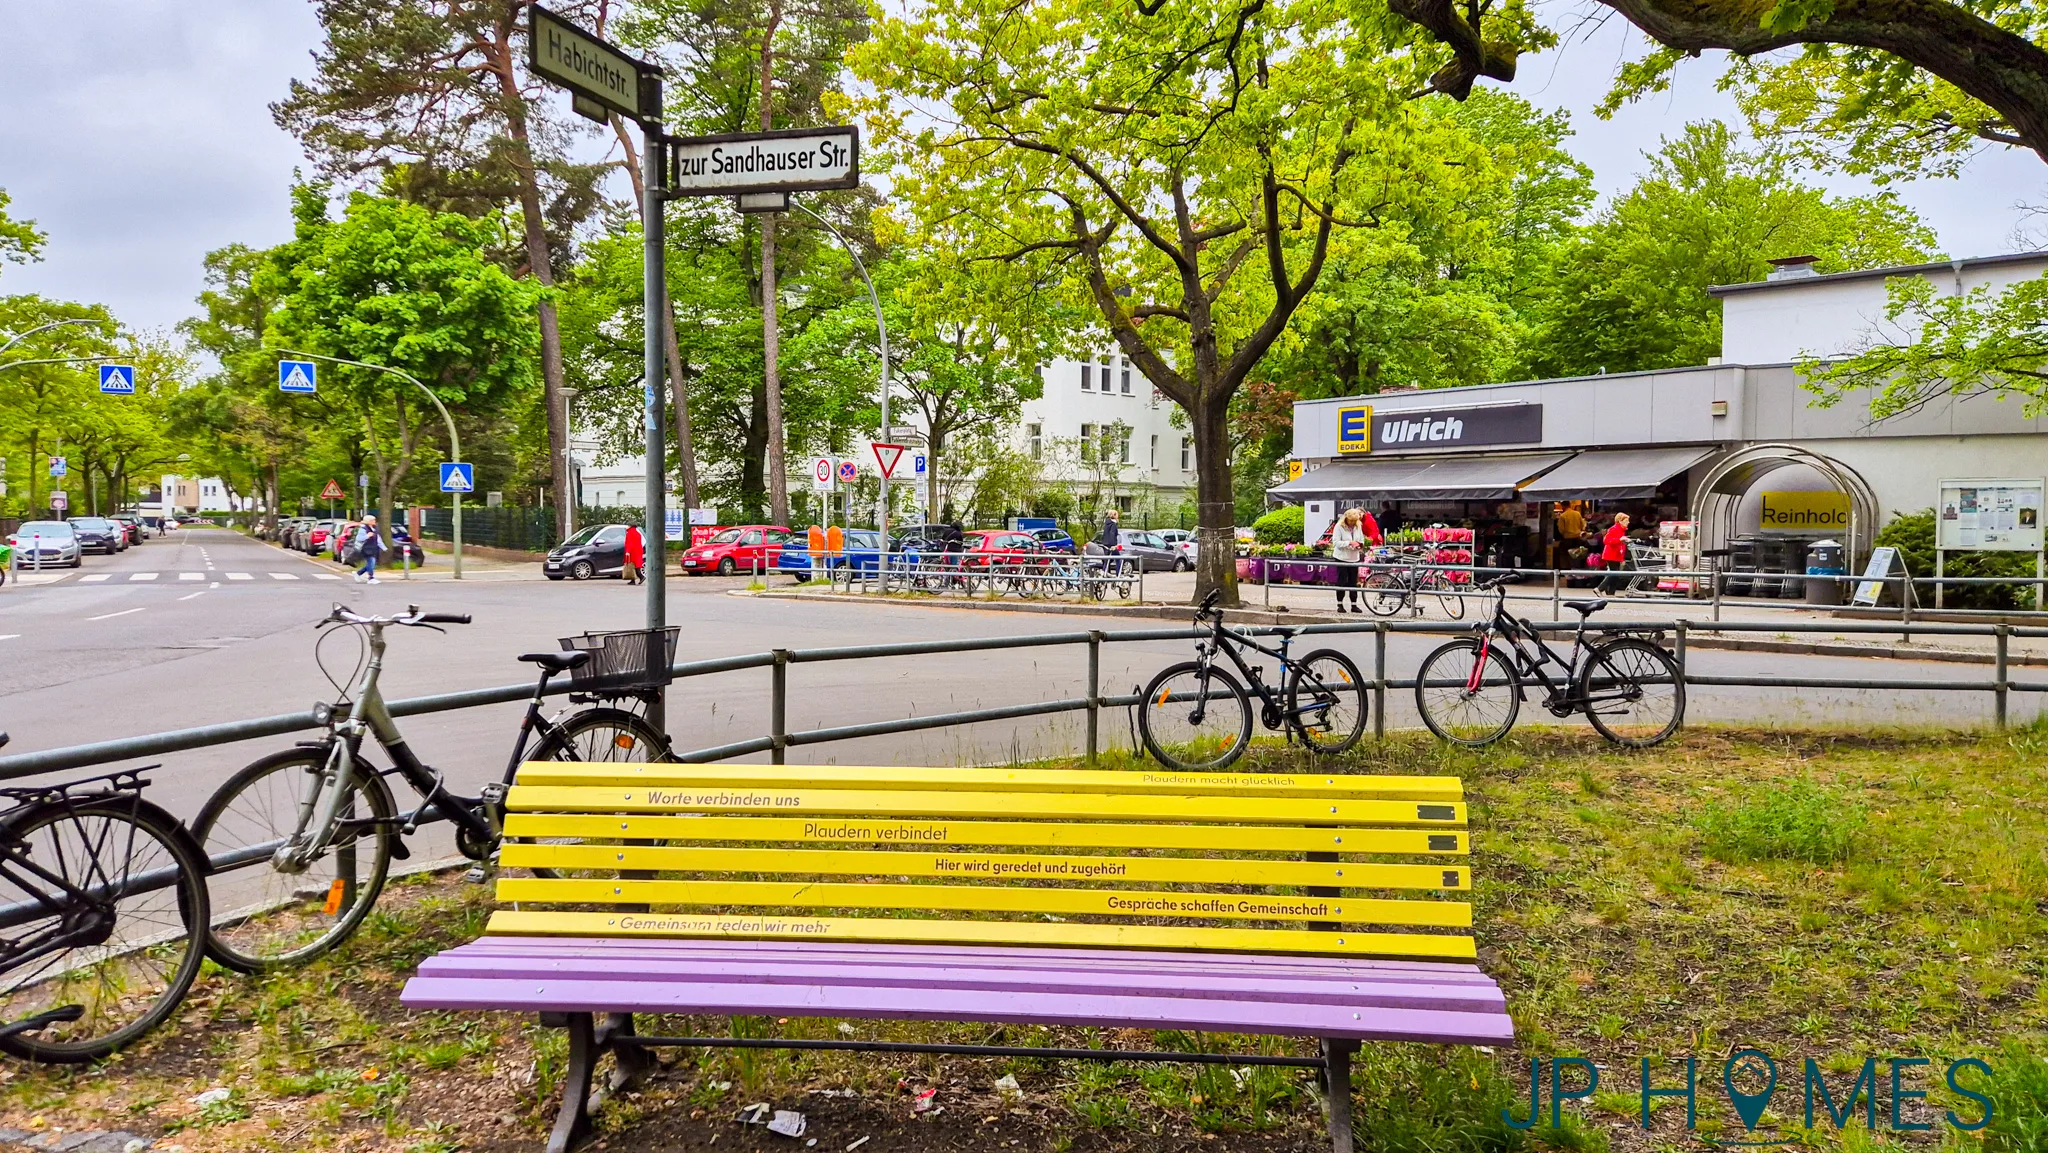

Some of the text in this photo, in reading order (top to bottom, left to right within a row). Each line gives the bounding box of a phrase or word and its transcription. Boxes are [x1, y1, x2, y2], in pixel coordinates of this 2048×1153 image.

[548, 28, 630, 98] Habichtstr.
[681, 140, 849, 176] zur Sandhauser Str.
[1381, 417, 1463, 443] Ulrich
[820, 465, 827, 475] 30
[1143, 774, 1295, 786] Plaudern macht glücklich
[648, 791, 800, 806] Worte verbinden uns
[804, 823, 948, 840] Plaudern verbindet
[935, 858, 1126, 876] Hier wird geredet und zugehört
[1107, 897, 1328, 916] Gespräche schaffen Gemeinschaft
[620, 917, 830, 933] Gemeinsam reden wir mehr
